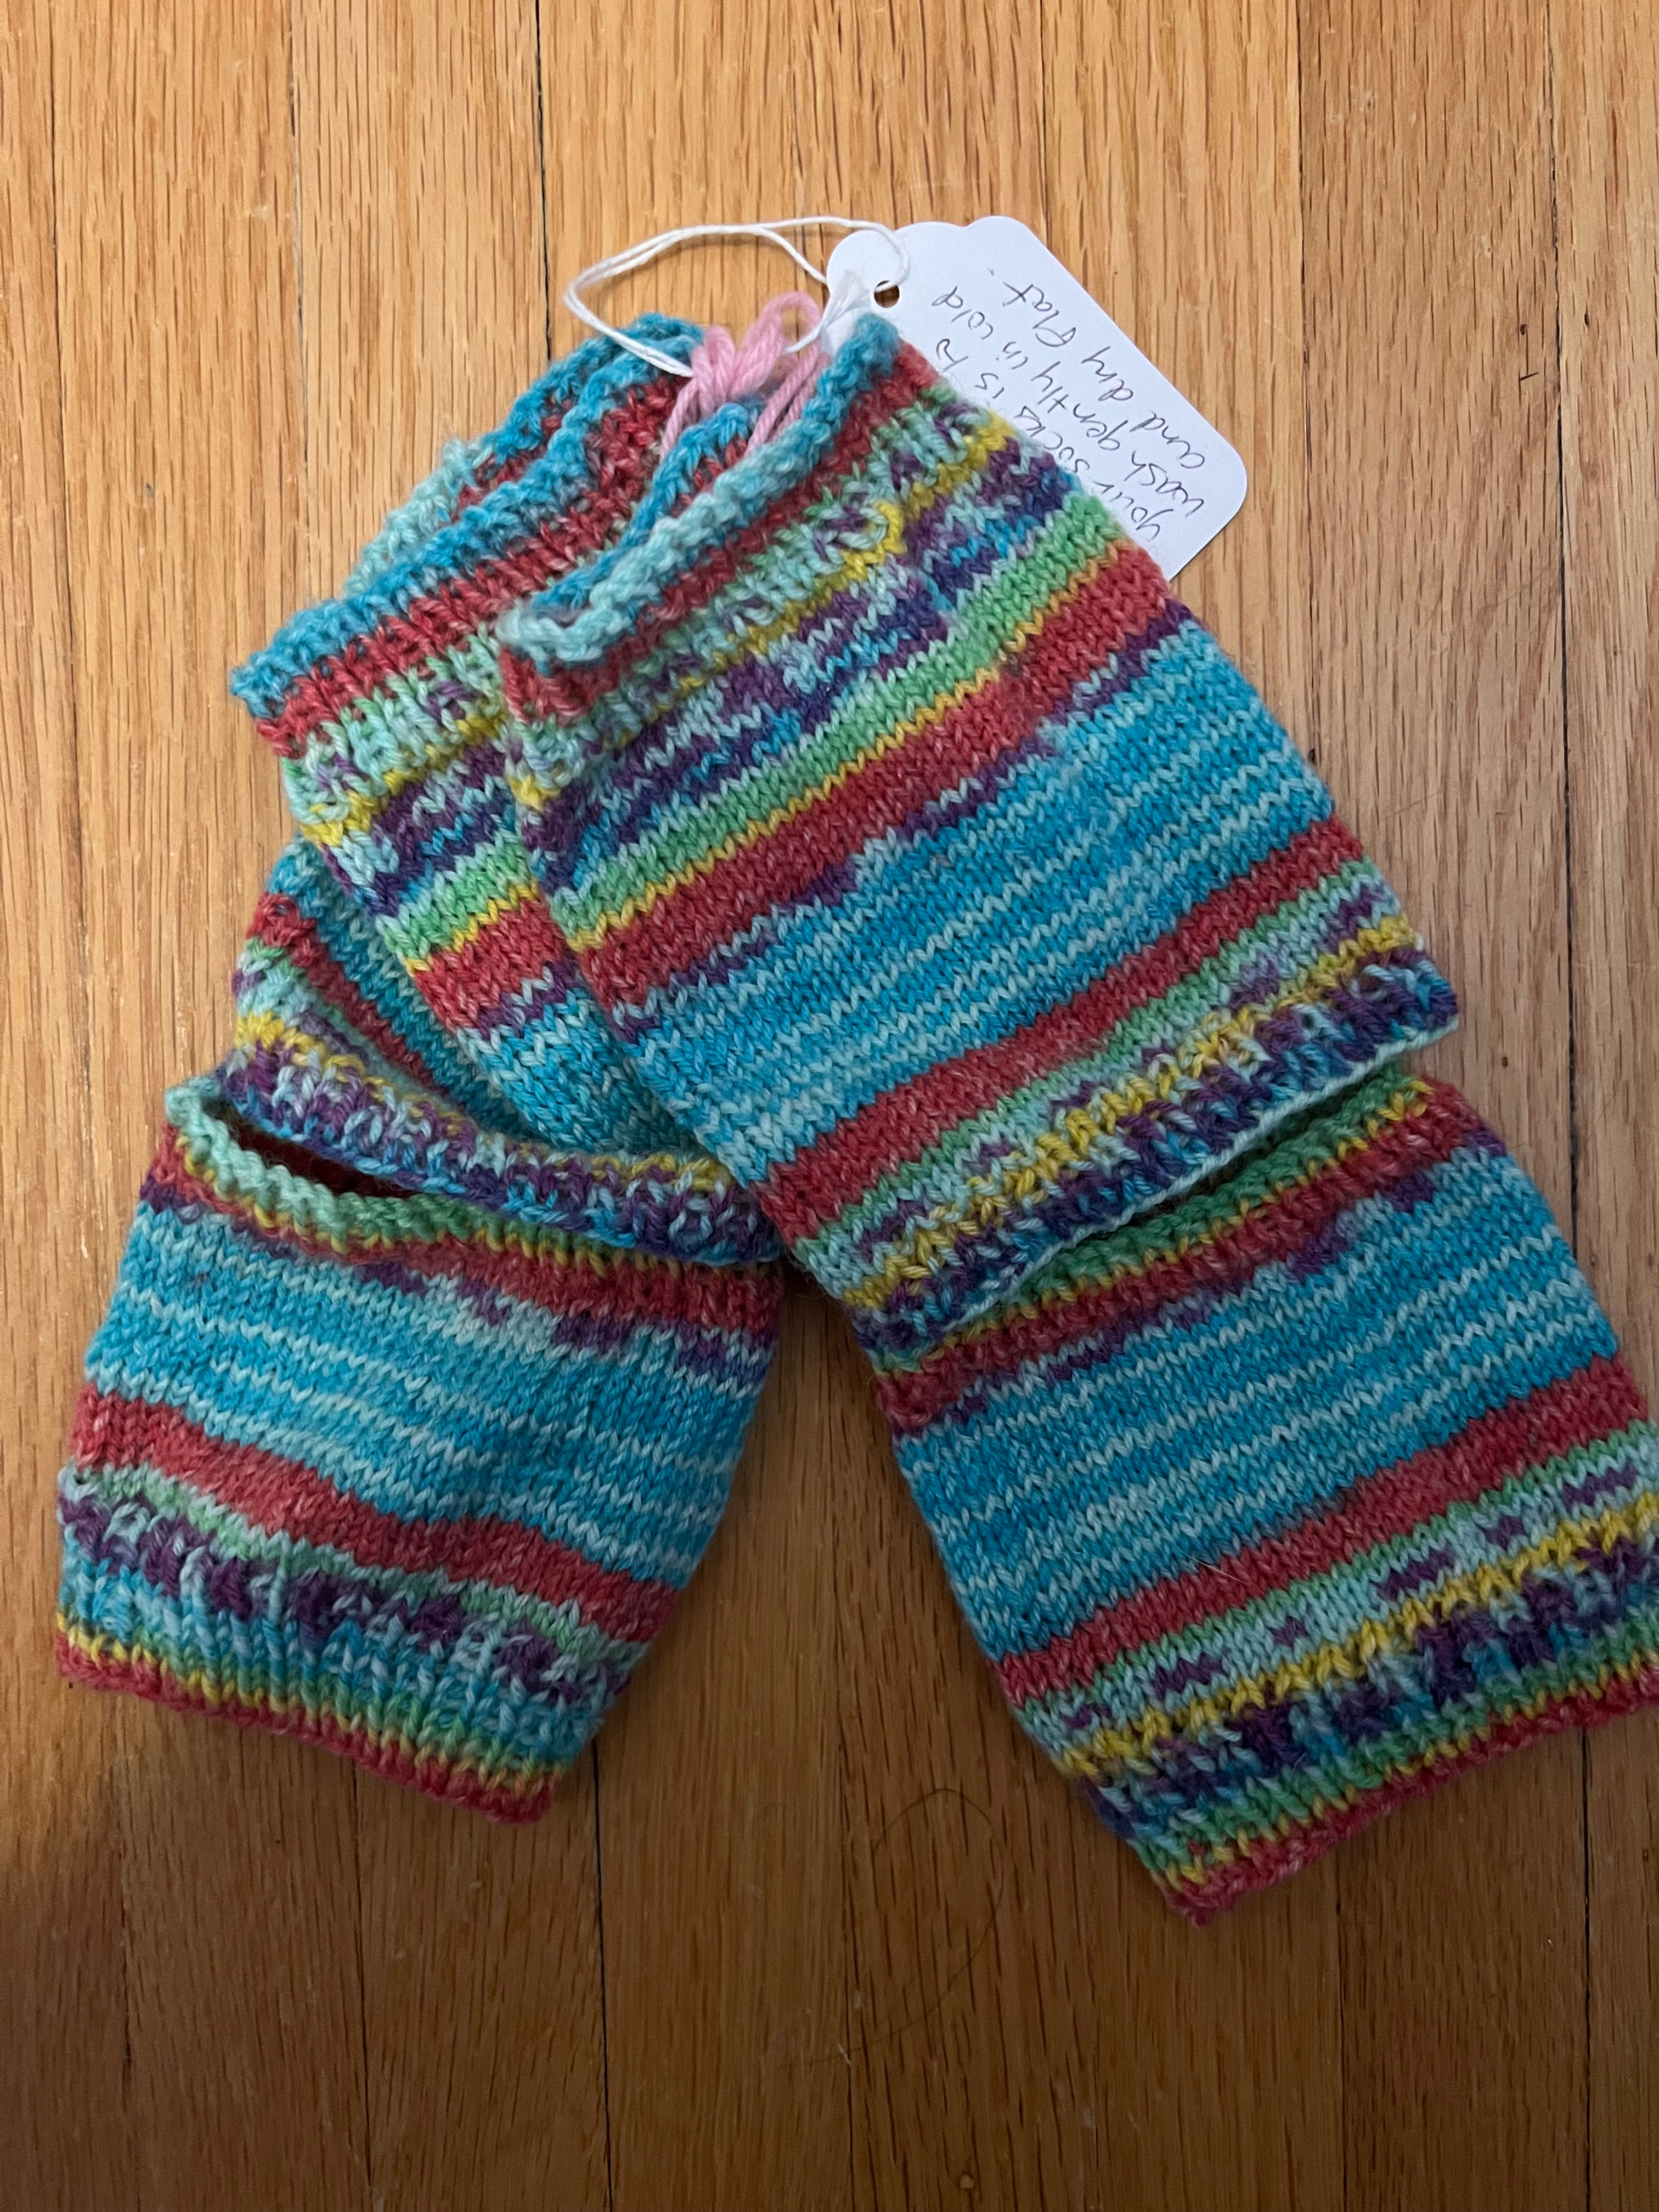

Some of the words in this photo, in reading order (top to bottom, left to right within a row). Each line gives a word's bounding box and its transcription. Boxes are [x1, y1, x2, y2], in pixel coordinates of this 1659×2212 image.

[932, 285, 994, 340] cold
[936, 338, 969, 373] to
[996, 341, 1029, 370] in
[1081, 346, 1134, 402] dry
[975, 372, 1005, 399] is
[1030, 361, 1128, 450] gently
[1129, 410, 1205, 469] and
[1124, 450, 1205, 518] wash
